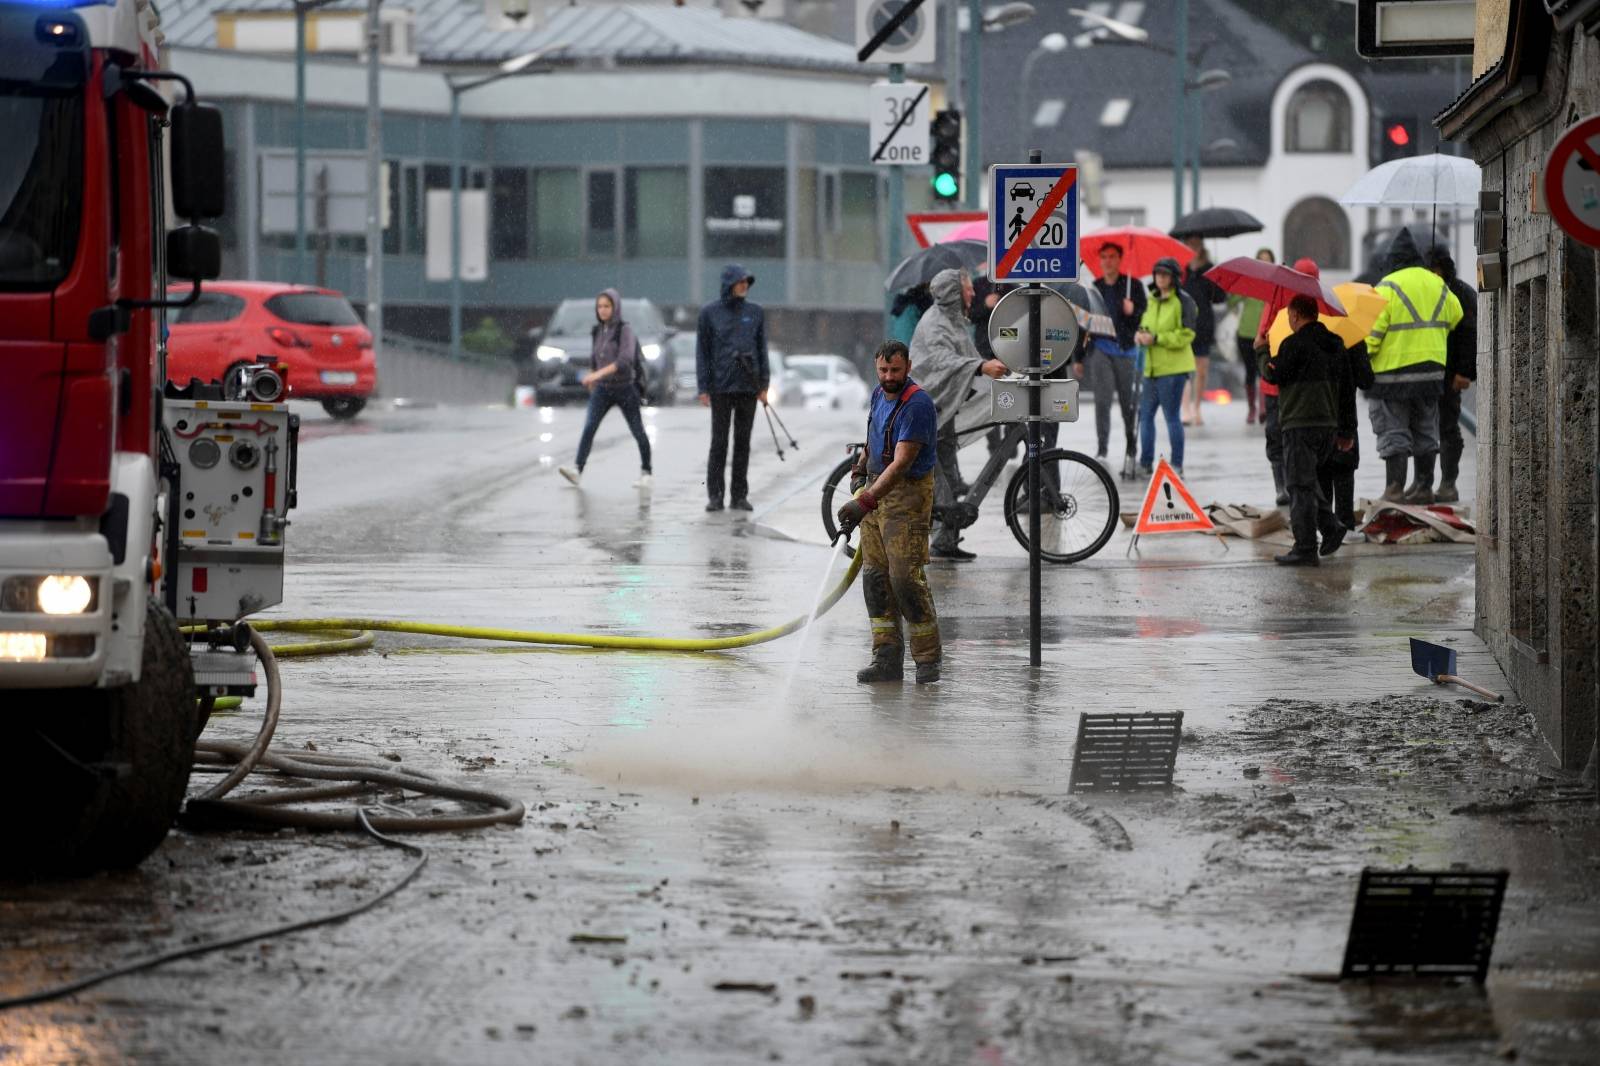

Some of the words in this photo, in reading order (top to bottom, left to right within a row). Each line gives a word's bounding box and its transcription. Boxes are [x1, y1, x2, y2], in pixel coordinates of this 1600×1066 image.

[884, 97, 915, 127] 30
[1039, 223, 1064, 246] 20
[1150, 512, 1194, 522] Feuerwehr
